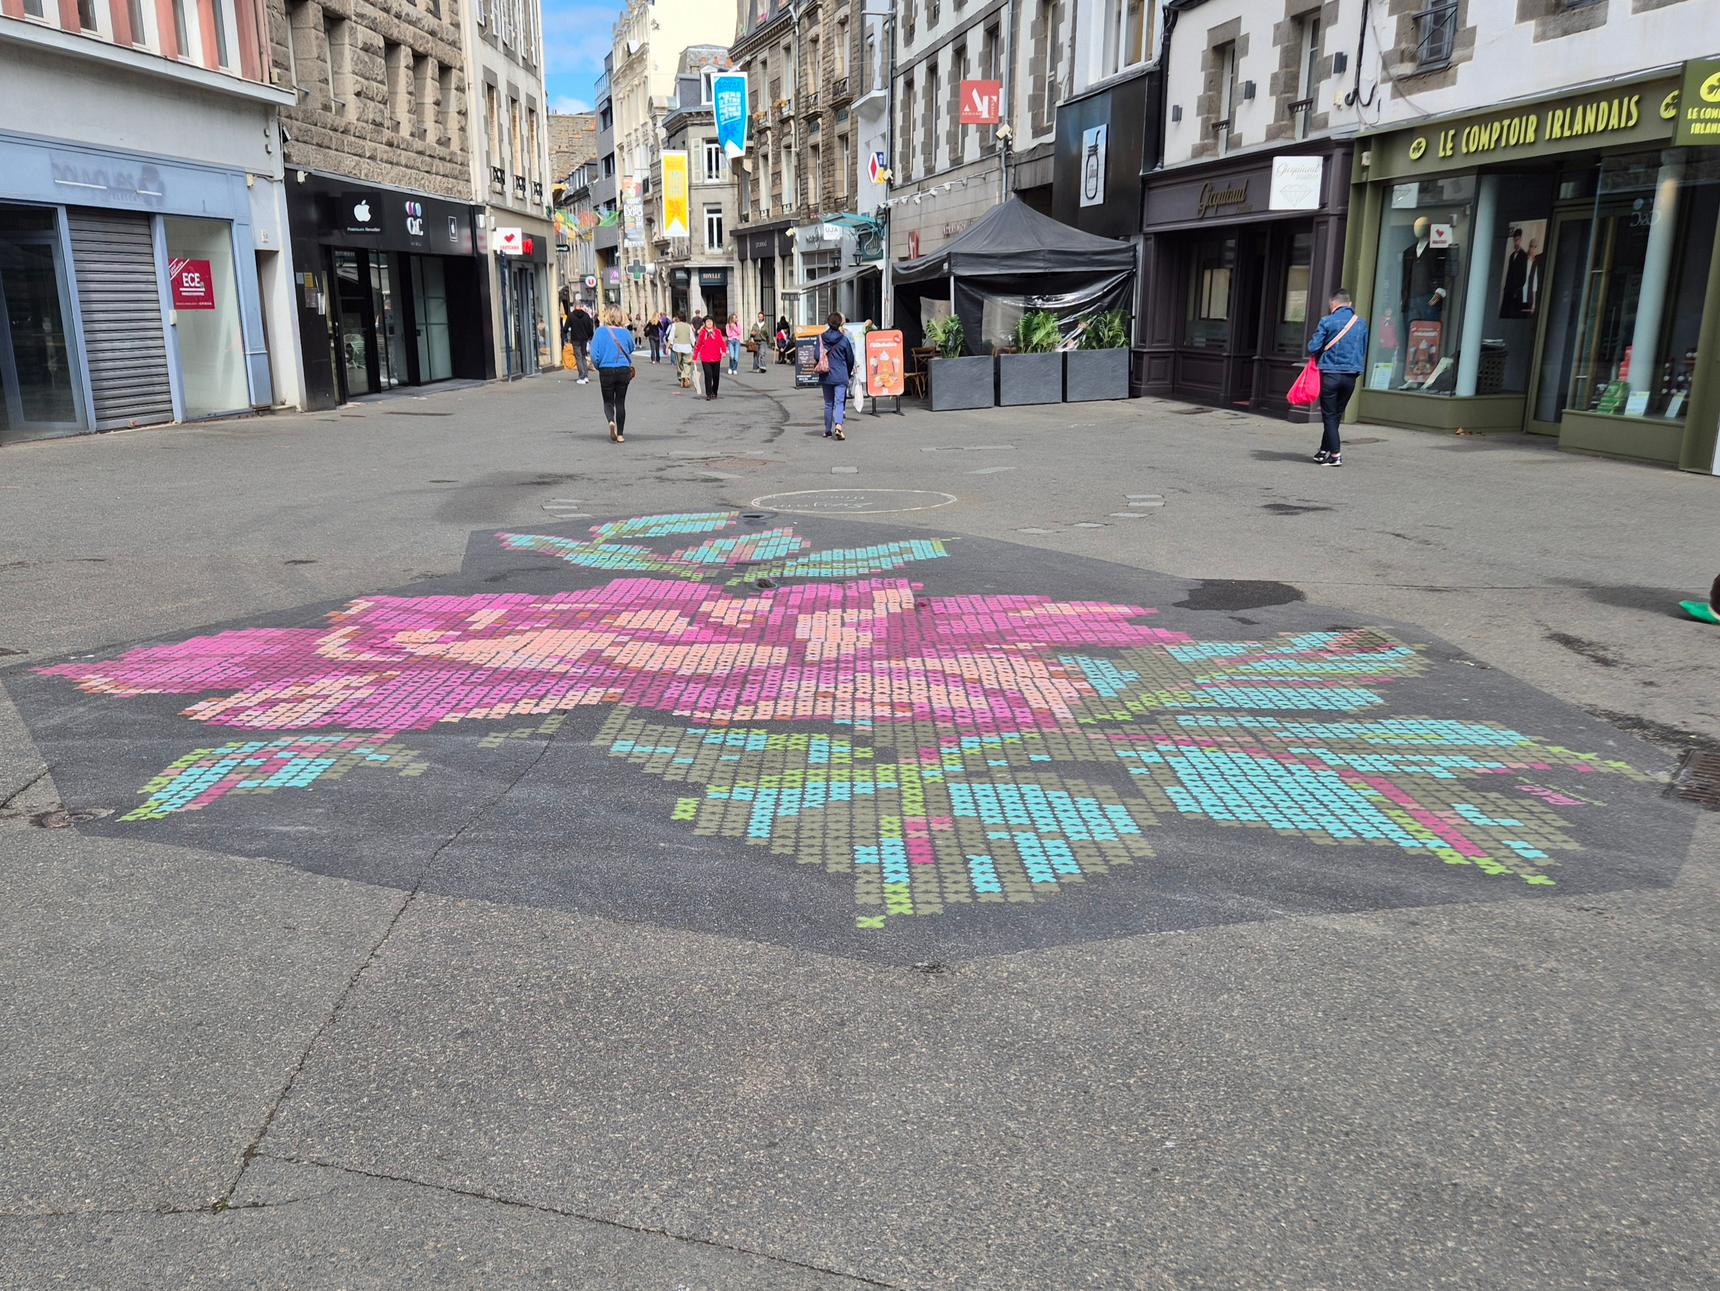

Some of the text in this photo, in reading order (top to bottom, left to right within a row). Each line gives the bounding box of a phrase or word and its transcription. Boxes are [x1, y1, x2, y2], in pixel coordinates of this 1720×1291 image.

[1687, 107, 1699, 120] LE
[1438, 94, 1641, 158] LE COMPTOIR IRLANDAIS
[182, 272, 201, 287] ECE
